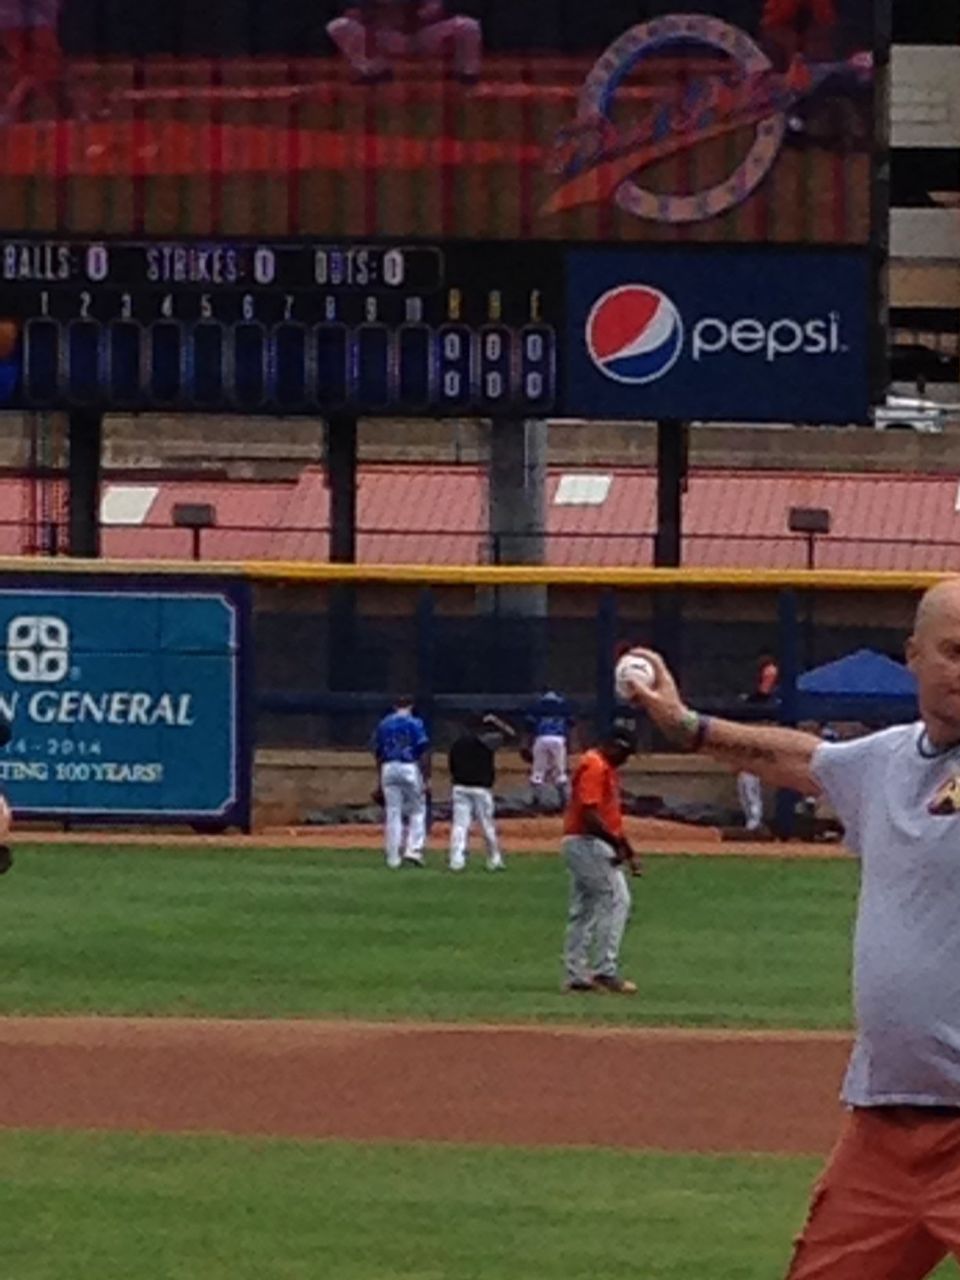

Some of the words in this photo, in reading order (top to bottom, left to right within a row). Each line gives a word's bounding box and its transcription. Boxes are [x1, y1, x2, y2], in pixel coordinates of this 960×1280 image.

[87, 245, 109, 281] 0
[254, 249, 275, 285] 0
[383, 249, 404, 286] 0
[40, 291, 49, 316] 1
[79, 291, 91, 318] 2
[161, 294, 172, 317] 4
[201, 294, 212, 318] 5
[243, 294, 254, 320] 6
[444, 333, 461, 361] 0
[485, 332, 501, 361] 0
[526, 333, 543, 362] 0
[692, 311, 838, 361] pepsi
[444, 371, 461, 397] 0
[486, 371, 502, 398] 0
[525, 371, 543, 399] 0
[28, 689, 195, 726] GENERAL
[55, 762, 90, 781] 100
